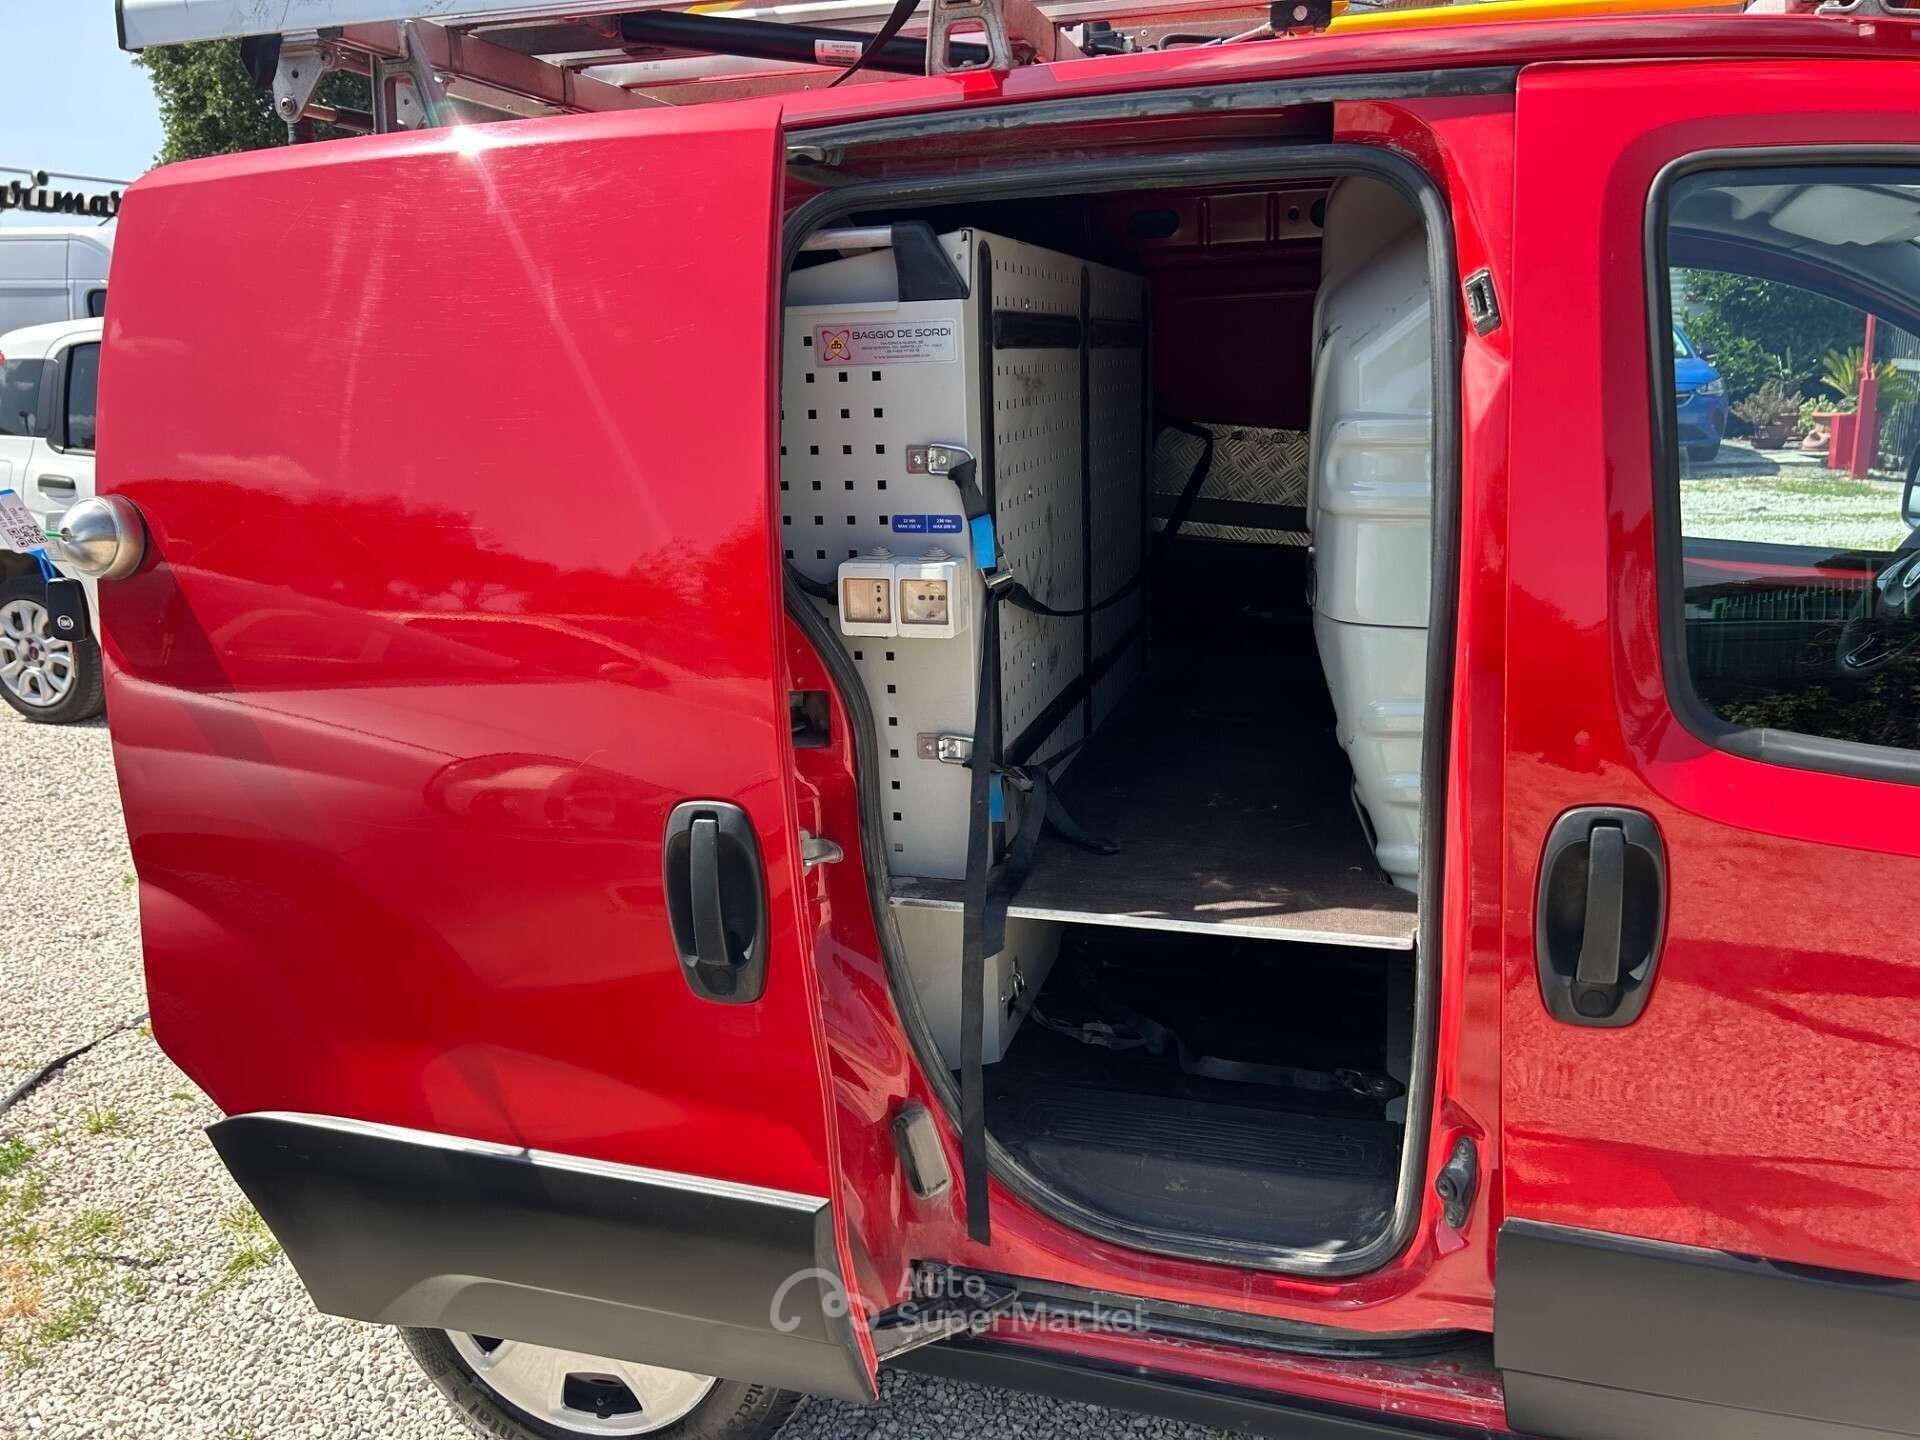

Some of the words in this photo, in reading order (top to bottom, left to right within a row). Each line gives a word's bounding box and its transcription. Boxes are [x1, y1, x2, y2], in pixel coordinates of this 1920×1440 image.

[852, 330, 895, 340] BAGGIO
[897, 329, 912, 338] DE
[915, 328, 951, 337] SORDI
